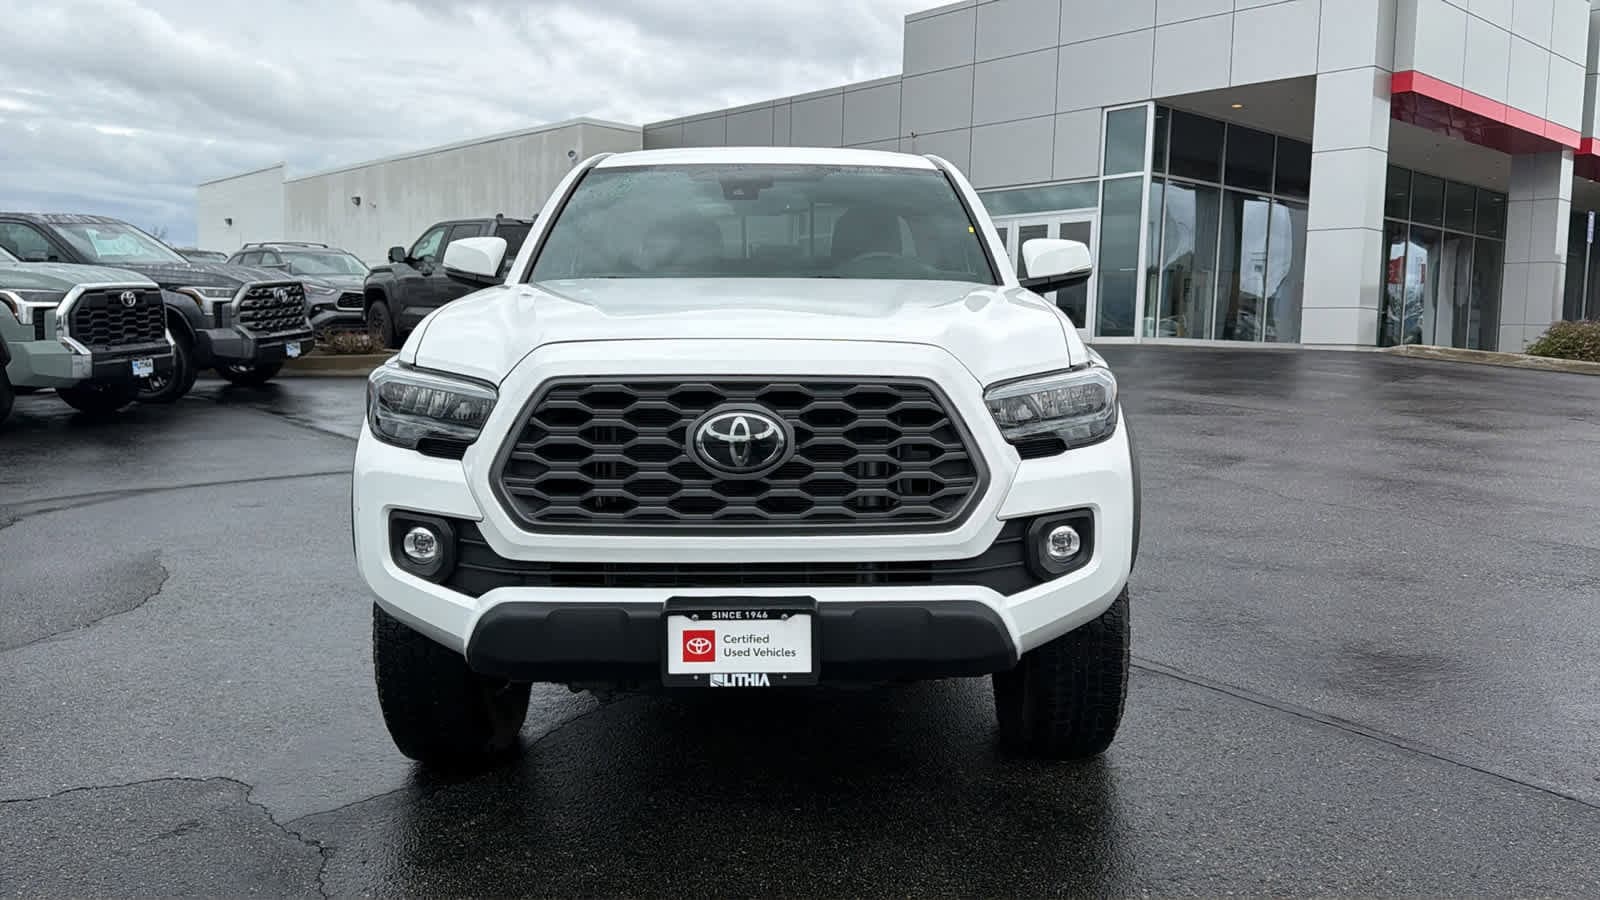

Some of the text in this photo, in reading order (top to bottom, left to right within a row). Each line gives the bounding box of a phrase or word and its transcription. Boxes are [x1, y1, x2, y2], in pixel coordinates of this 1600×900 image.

[711, 611, 769, 619] SINCE 1946
[723, 634, 770, 644] Certified
[723, 647, 796, 657] Used Vehicles
[724, 673, 770, 687] LITHIA
